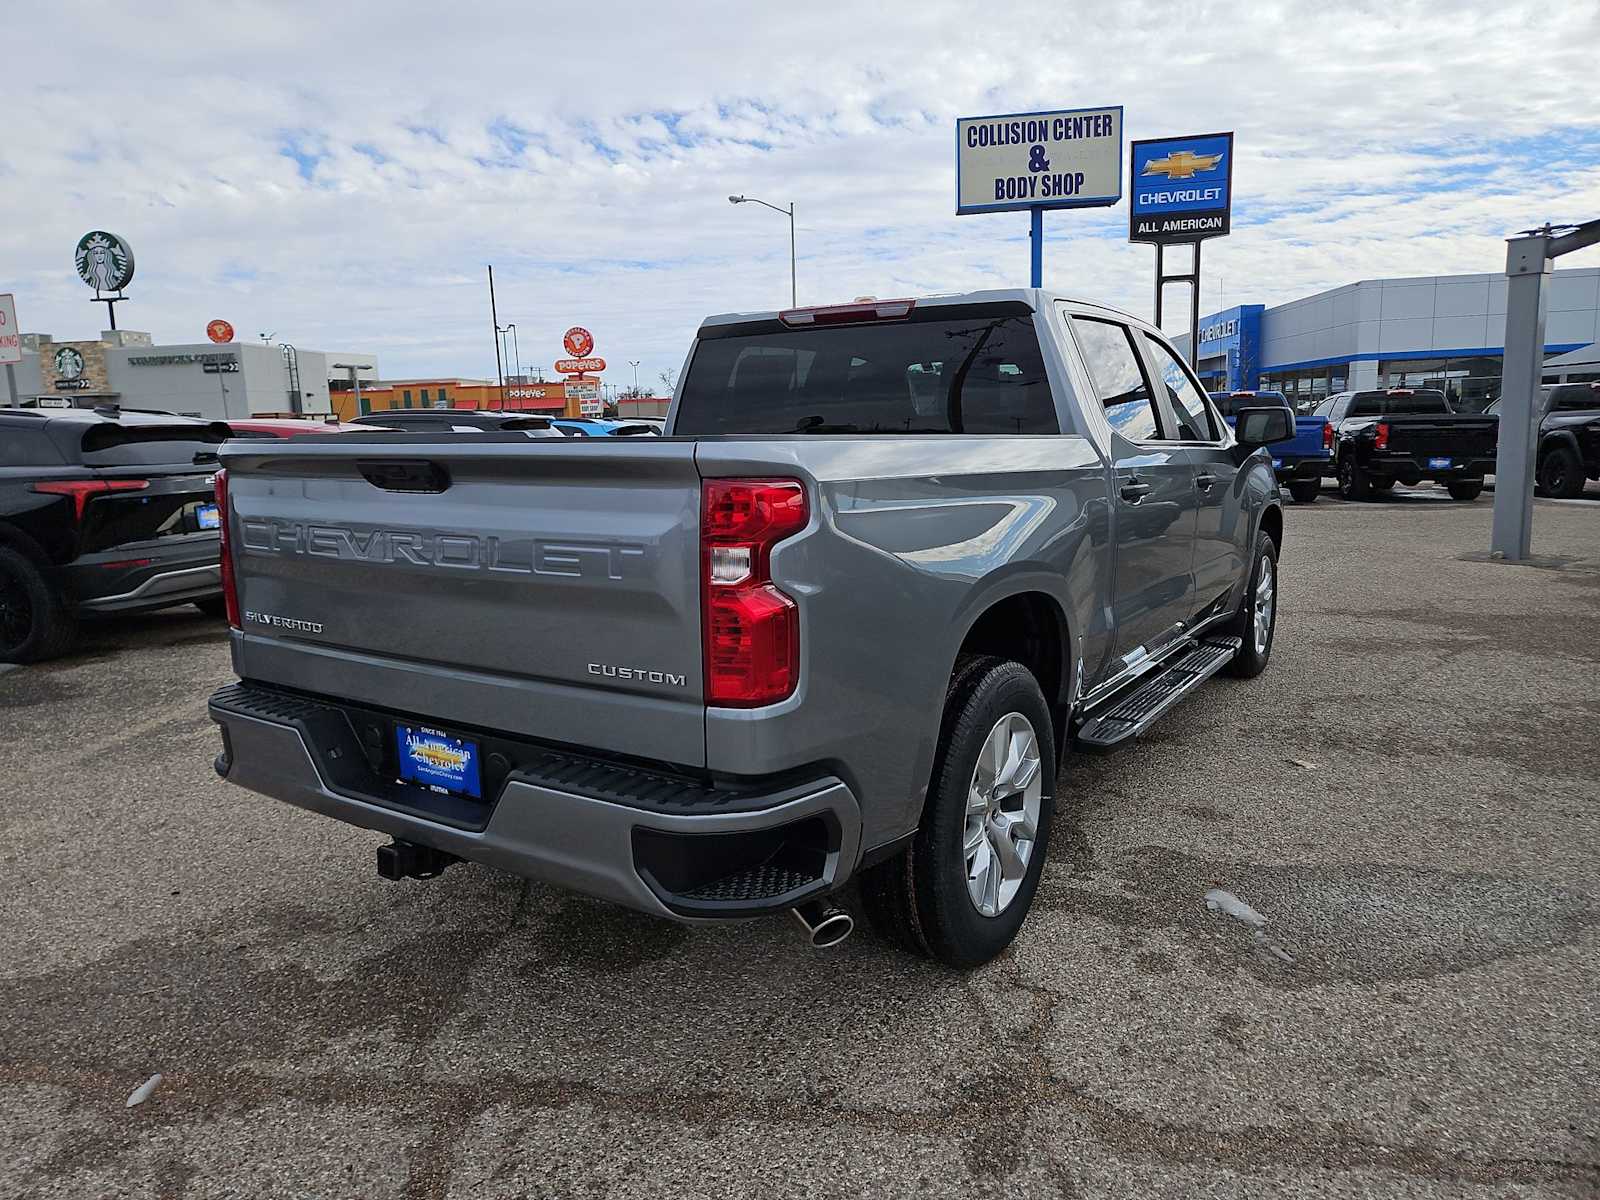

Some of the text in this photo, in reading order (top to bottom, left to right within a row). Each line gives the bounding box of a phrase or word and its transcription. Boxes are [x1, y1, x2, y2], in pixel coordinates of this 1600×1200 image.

[967, 114, 1113, 148] COLLISION CENTER
[1028, 145, 1050, 172] &
[995, 172, 1085, 200] BODY SHOP
[1139, 187, 1222, 205] CHEVROLET
[1138, 217, 1222, 234] ALL AMERICAN
[1201, 319, 1237, 343] CHEVROLET
[241, 519, 645, 580] CHEVROLET
[245, 611, 324, 634] SILVERADO
[587, 663, 686, 686] CUSTOM
[406, 735, 471, 760] All American
[415, 751, 465, 773] Chevrolet
